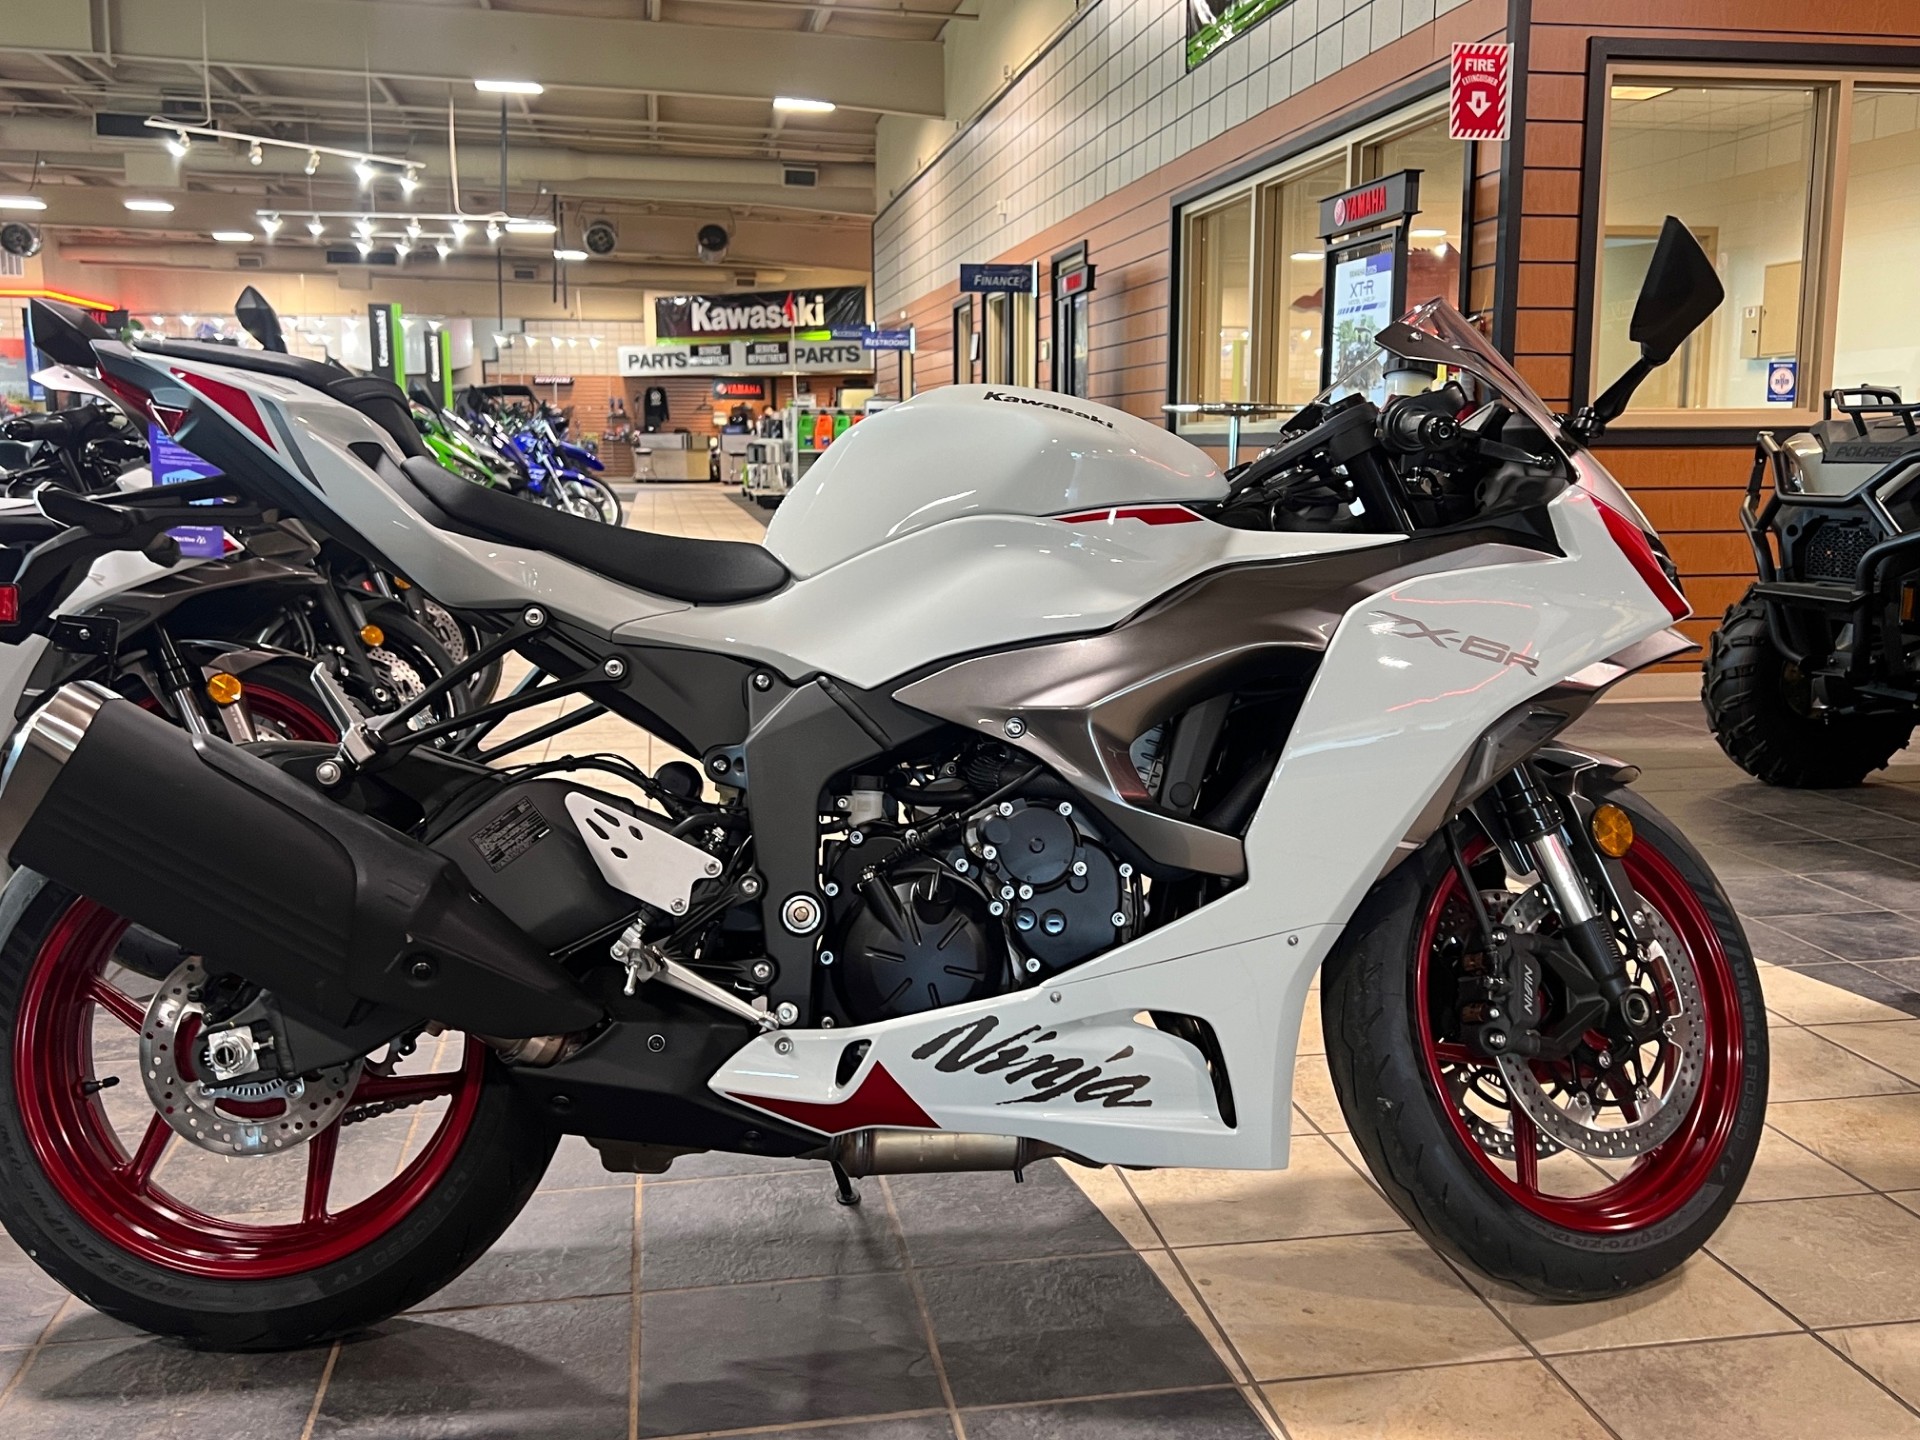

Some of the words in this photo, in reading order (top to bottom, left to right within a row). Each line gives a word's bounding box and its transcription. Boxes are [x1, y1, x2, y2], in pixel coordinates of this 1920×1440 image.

[1465, 58, 1496, 72] FIRE
[1461, 74, 1499, 87] EXTINGUISHER
[1346, 186, 1387, 222] YAMAHA
[974, 274, 1021, 286] FINANCE
[865, 337, 910, 347] RESTROOMS
[628, 352, 687, 369] PARTS
[795, 345, 861, 364] PARTS
[727, 383, 762, 395] YAMAHA
[983, 391, 1114, 429] Kawasaki
[1835, 446, 1903, 458] POLARIS
[1364, 609, 1540, 677] ZX-6R
[911, 1015, 1153, 1107] Ninja
